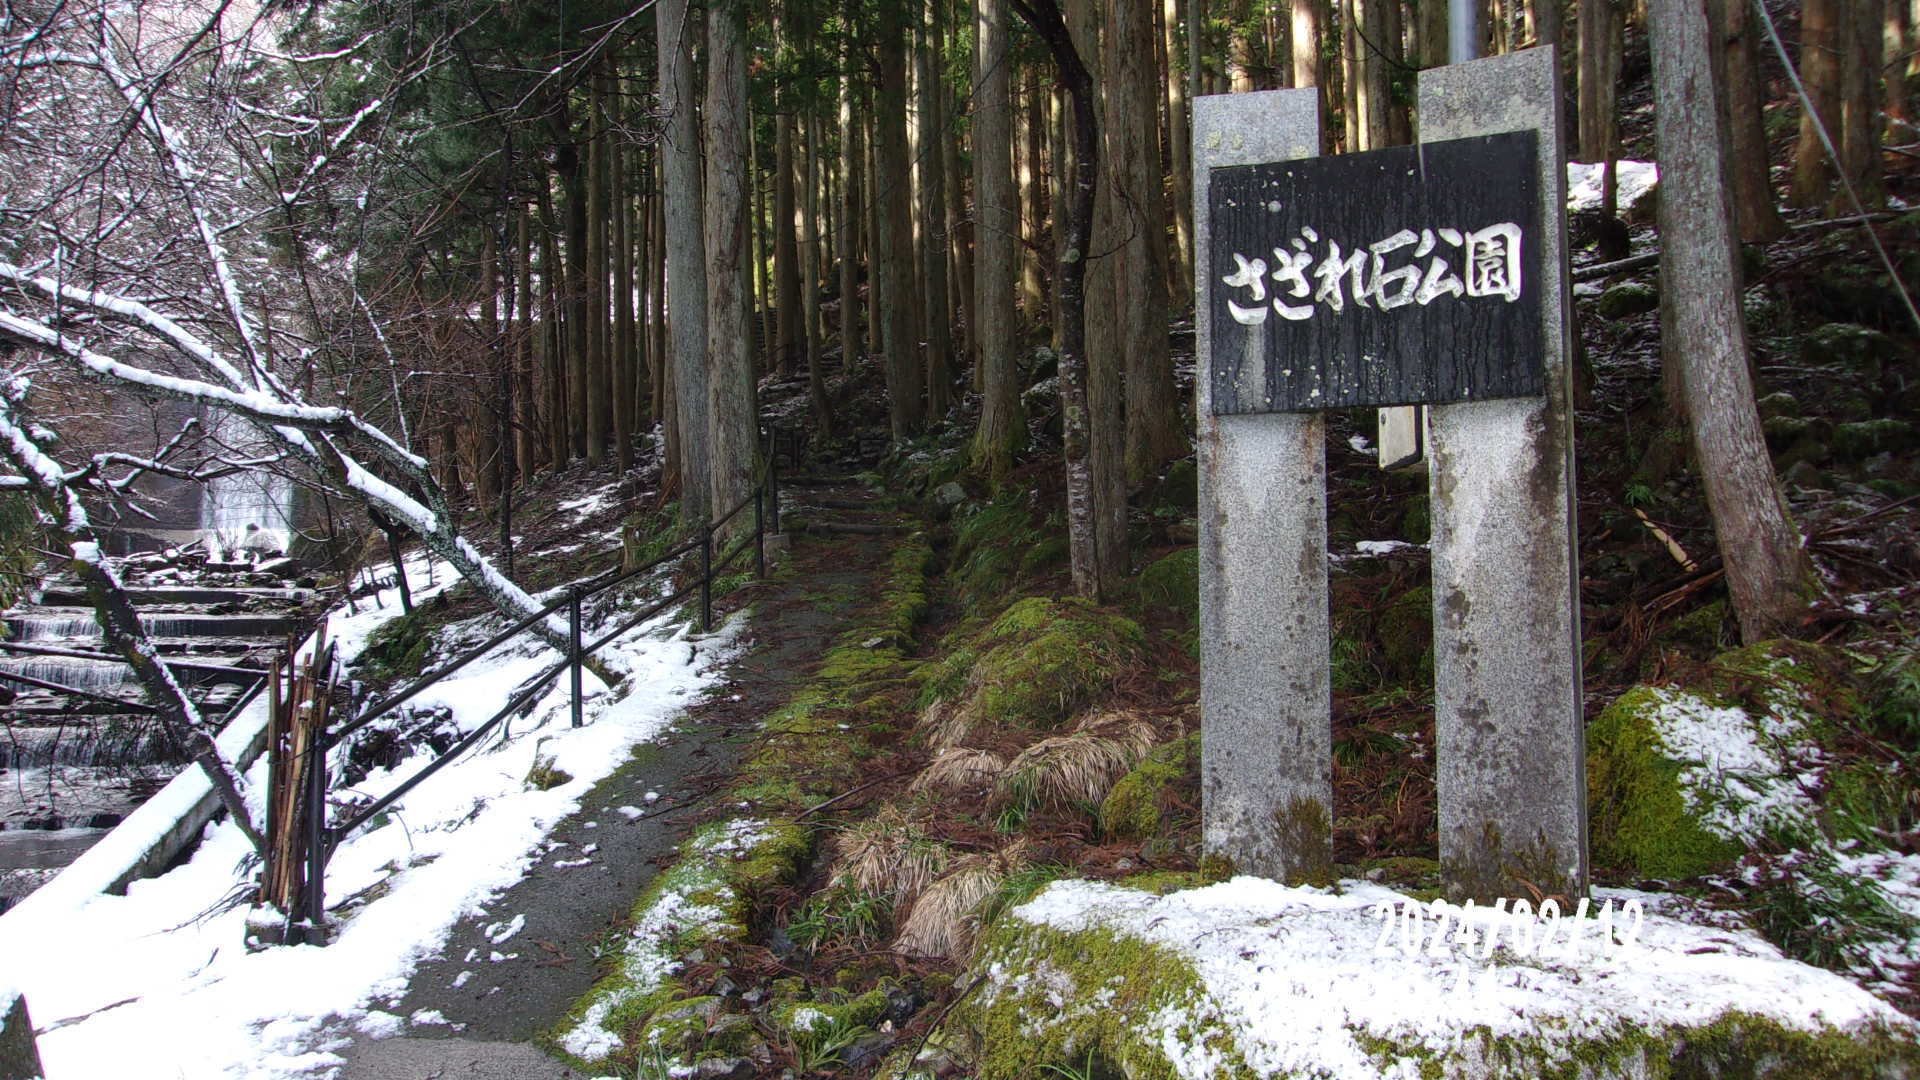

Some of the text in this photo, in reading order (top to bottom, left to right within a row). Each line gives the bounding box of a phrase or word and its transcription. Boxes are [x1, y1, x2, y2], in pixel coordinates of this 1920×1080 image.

[1222, 222, 1522, 325] さざれ石公園
